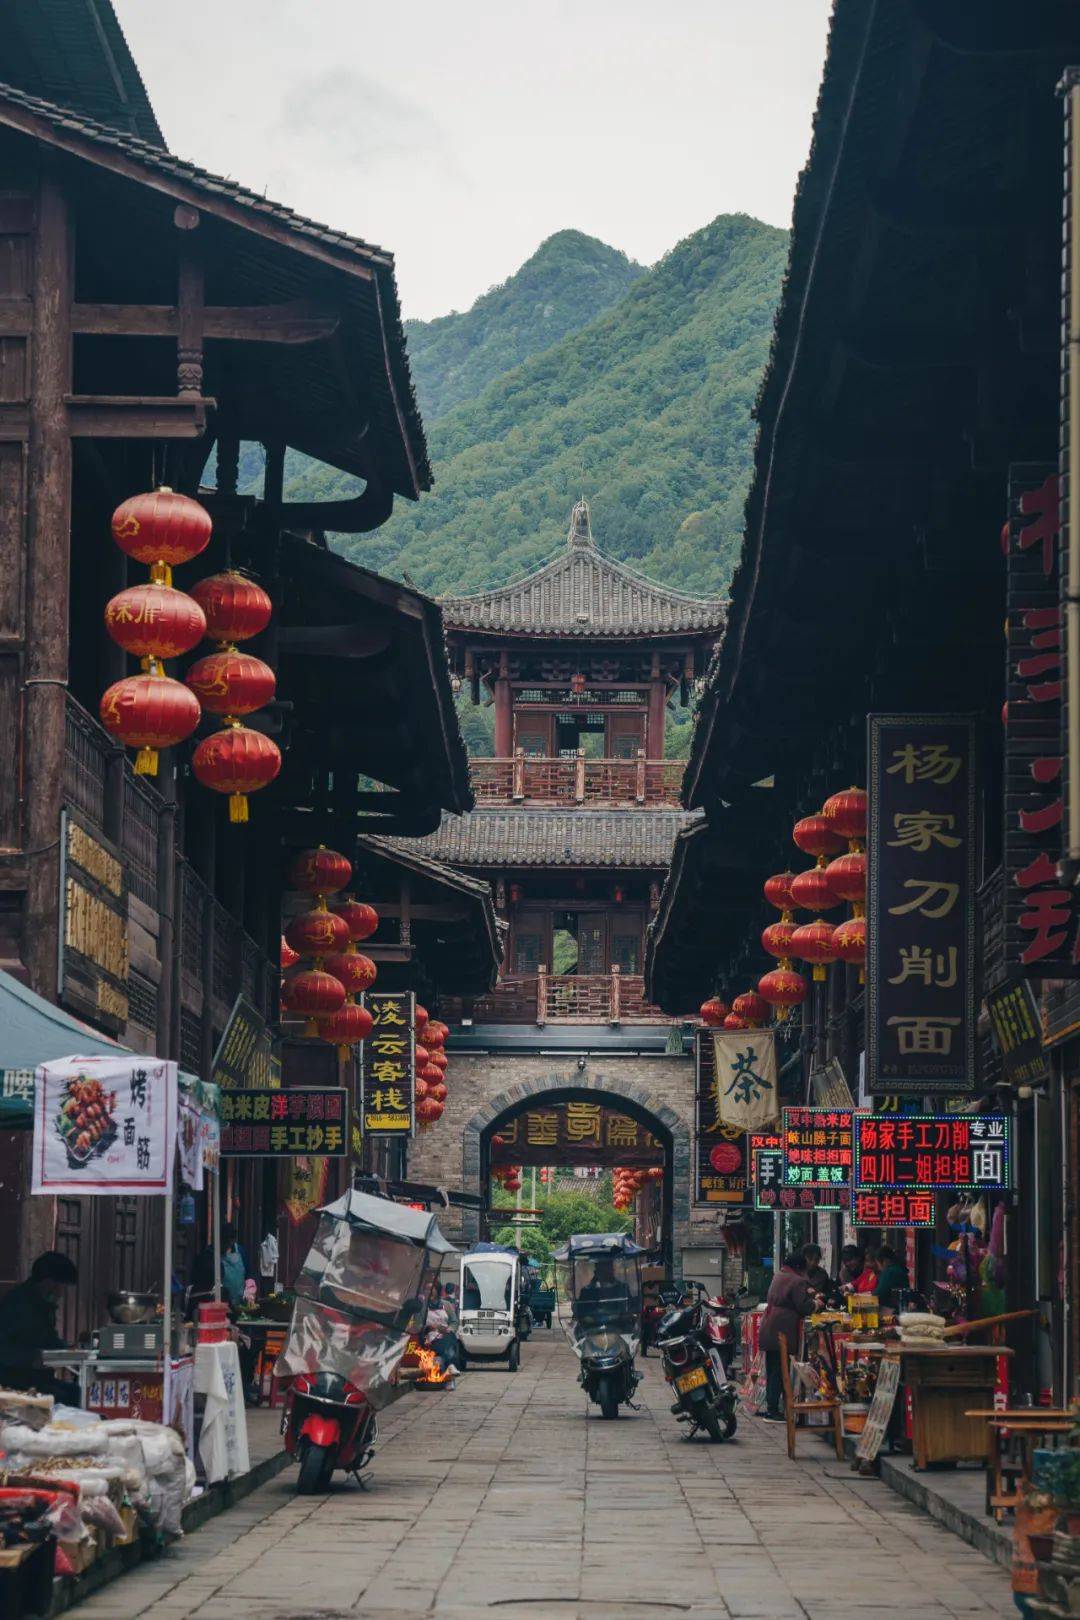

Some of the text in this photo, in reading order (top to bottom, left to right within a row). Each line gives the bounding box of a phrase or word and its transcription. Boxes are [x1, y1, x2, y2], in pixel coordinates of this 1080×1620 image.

[886, 742, 962, 1056] 杨家刀削面
[370, 999, 408, 1111] 凌云客栈
[723, 1047, 773, 1105] 茶
[123, 1068, 151, 1171] 烤面筋
[969, 1120, 1005, 1138] 专业
[751, 1135, 785, 1149] 汉中
[860, 1120, 970, 1151] 杨家手工刀削
[760, 1157, 783, 1186] 手
[787, 1165, 844, 1183] 炒面 盖饭
[860, 1152, 970, 1184] 四川二姐担担
[969, 1139, 1005, 1184] 面
[855, 1193, 932, 1222] 担担面
